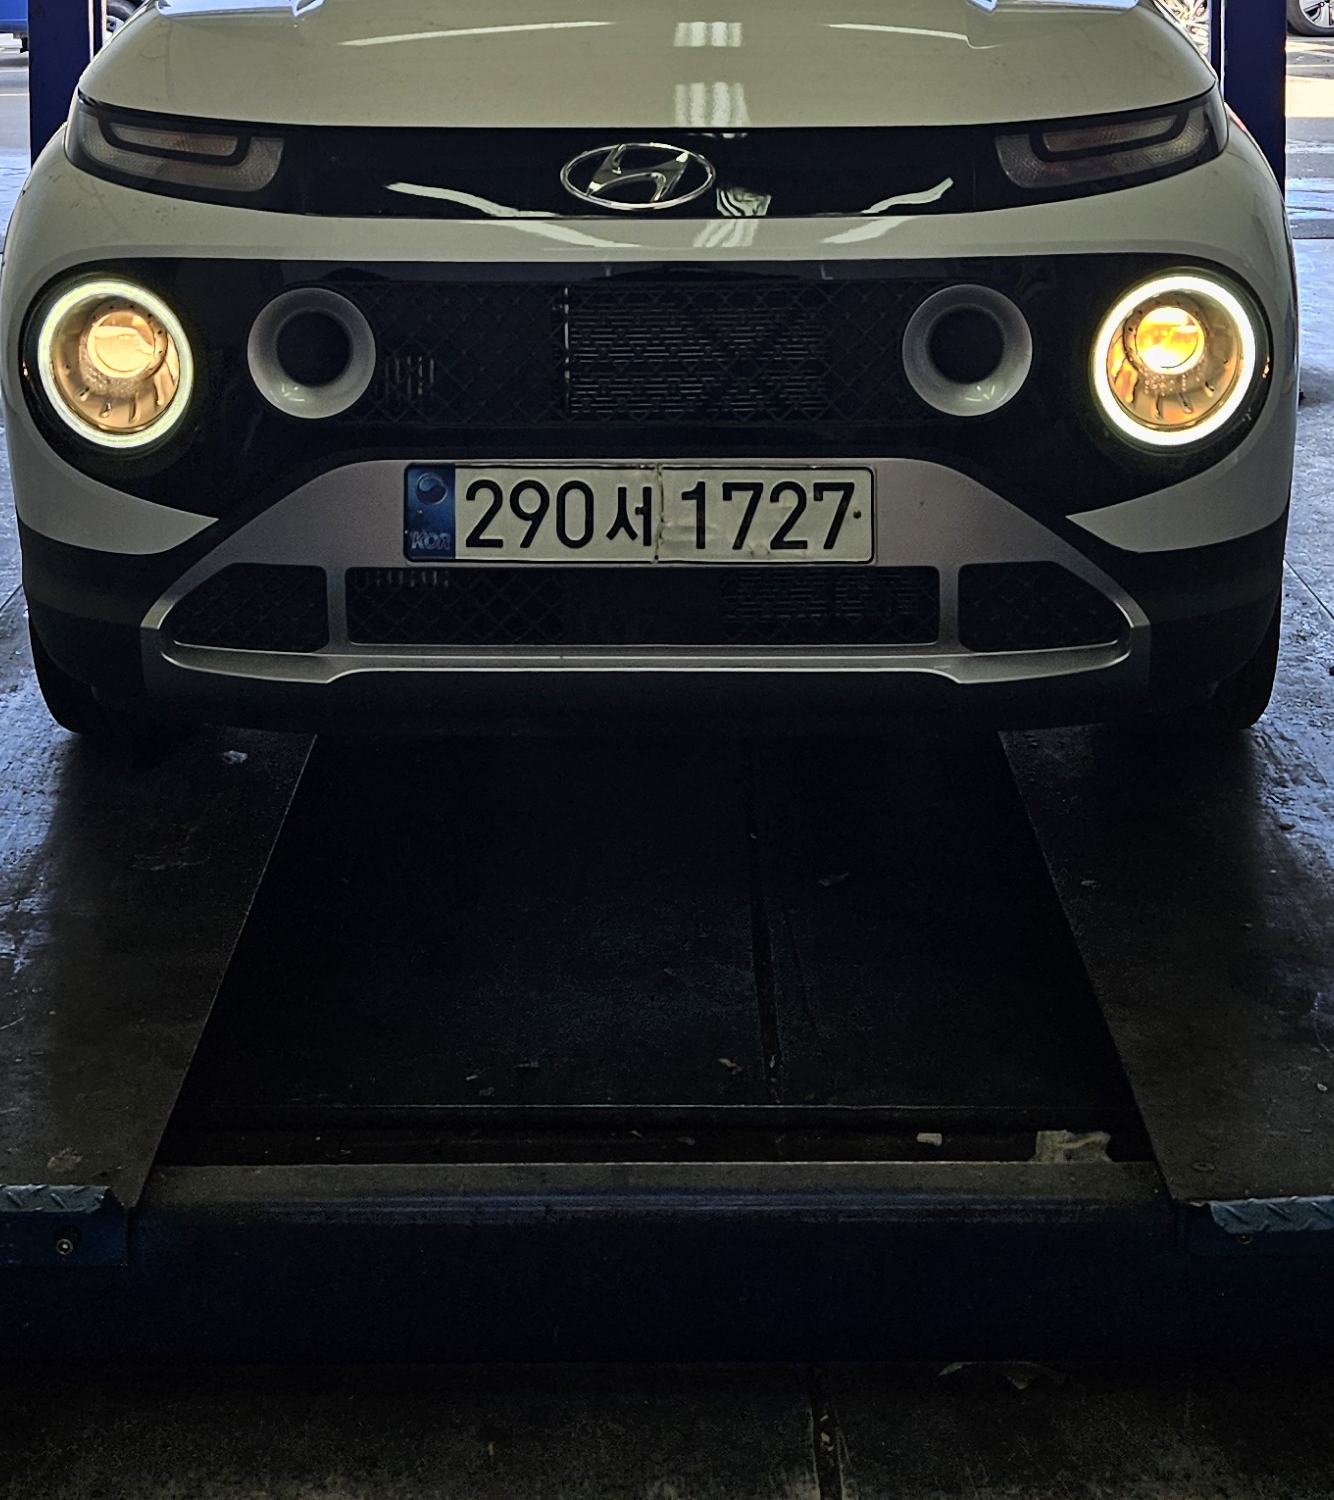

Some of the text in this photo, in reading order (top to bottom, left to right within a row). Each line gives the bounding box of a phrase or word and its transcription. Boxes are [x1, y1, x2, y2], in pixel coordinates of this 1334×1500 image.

[465, 478, 855, 550] 290서 1727
[410, 530, 451, 550] KOR
